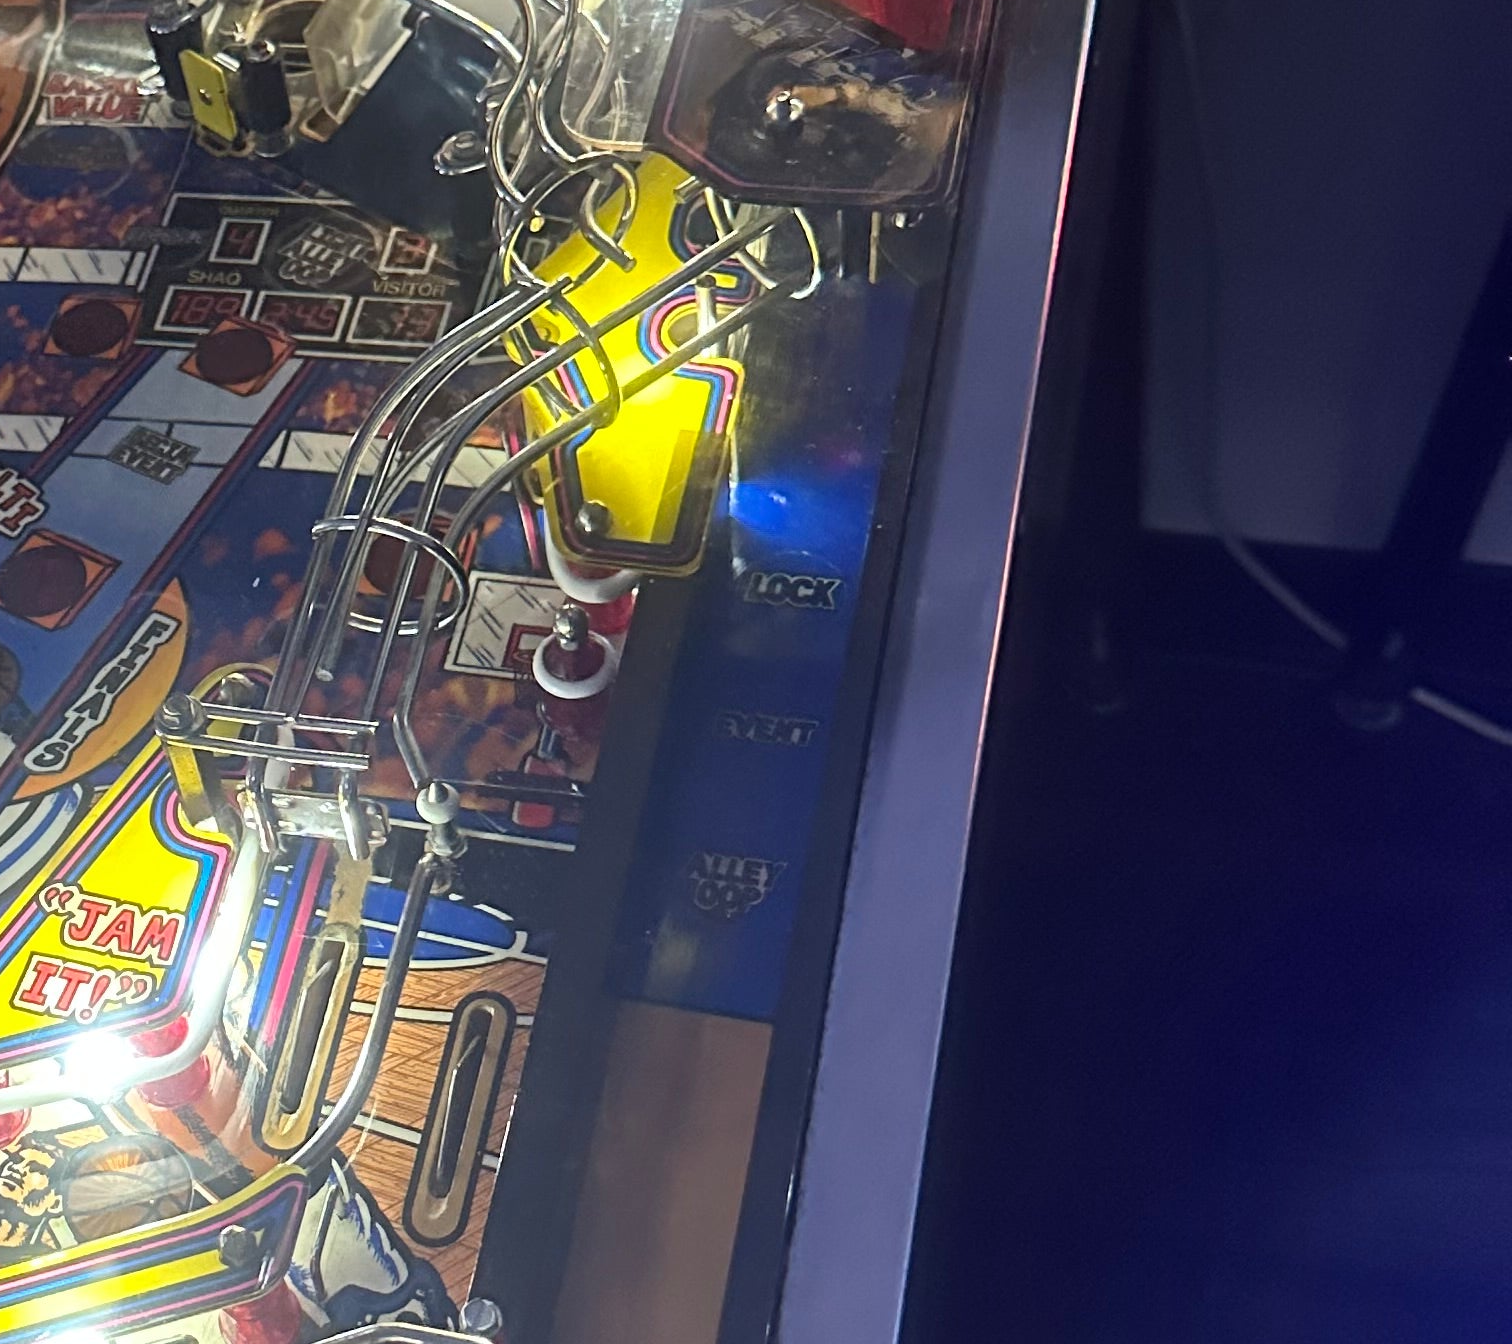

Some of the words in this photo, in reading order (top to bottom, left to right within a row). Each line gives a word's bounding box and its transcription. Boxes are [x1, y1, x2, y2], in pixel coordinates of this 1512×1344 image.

[187, 269, 243, 287] SHAQ
[744, 572, 842, 610] LOCK
[23, 611, 180, 774] FINALS
[717, 712, 820, 747] EVENT
